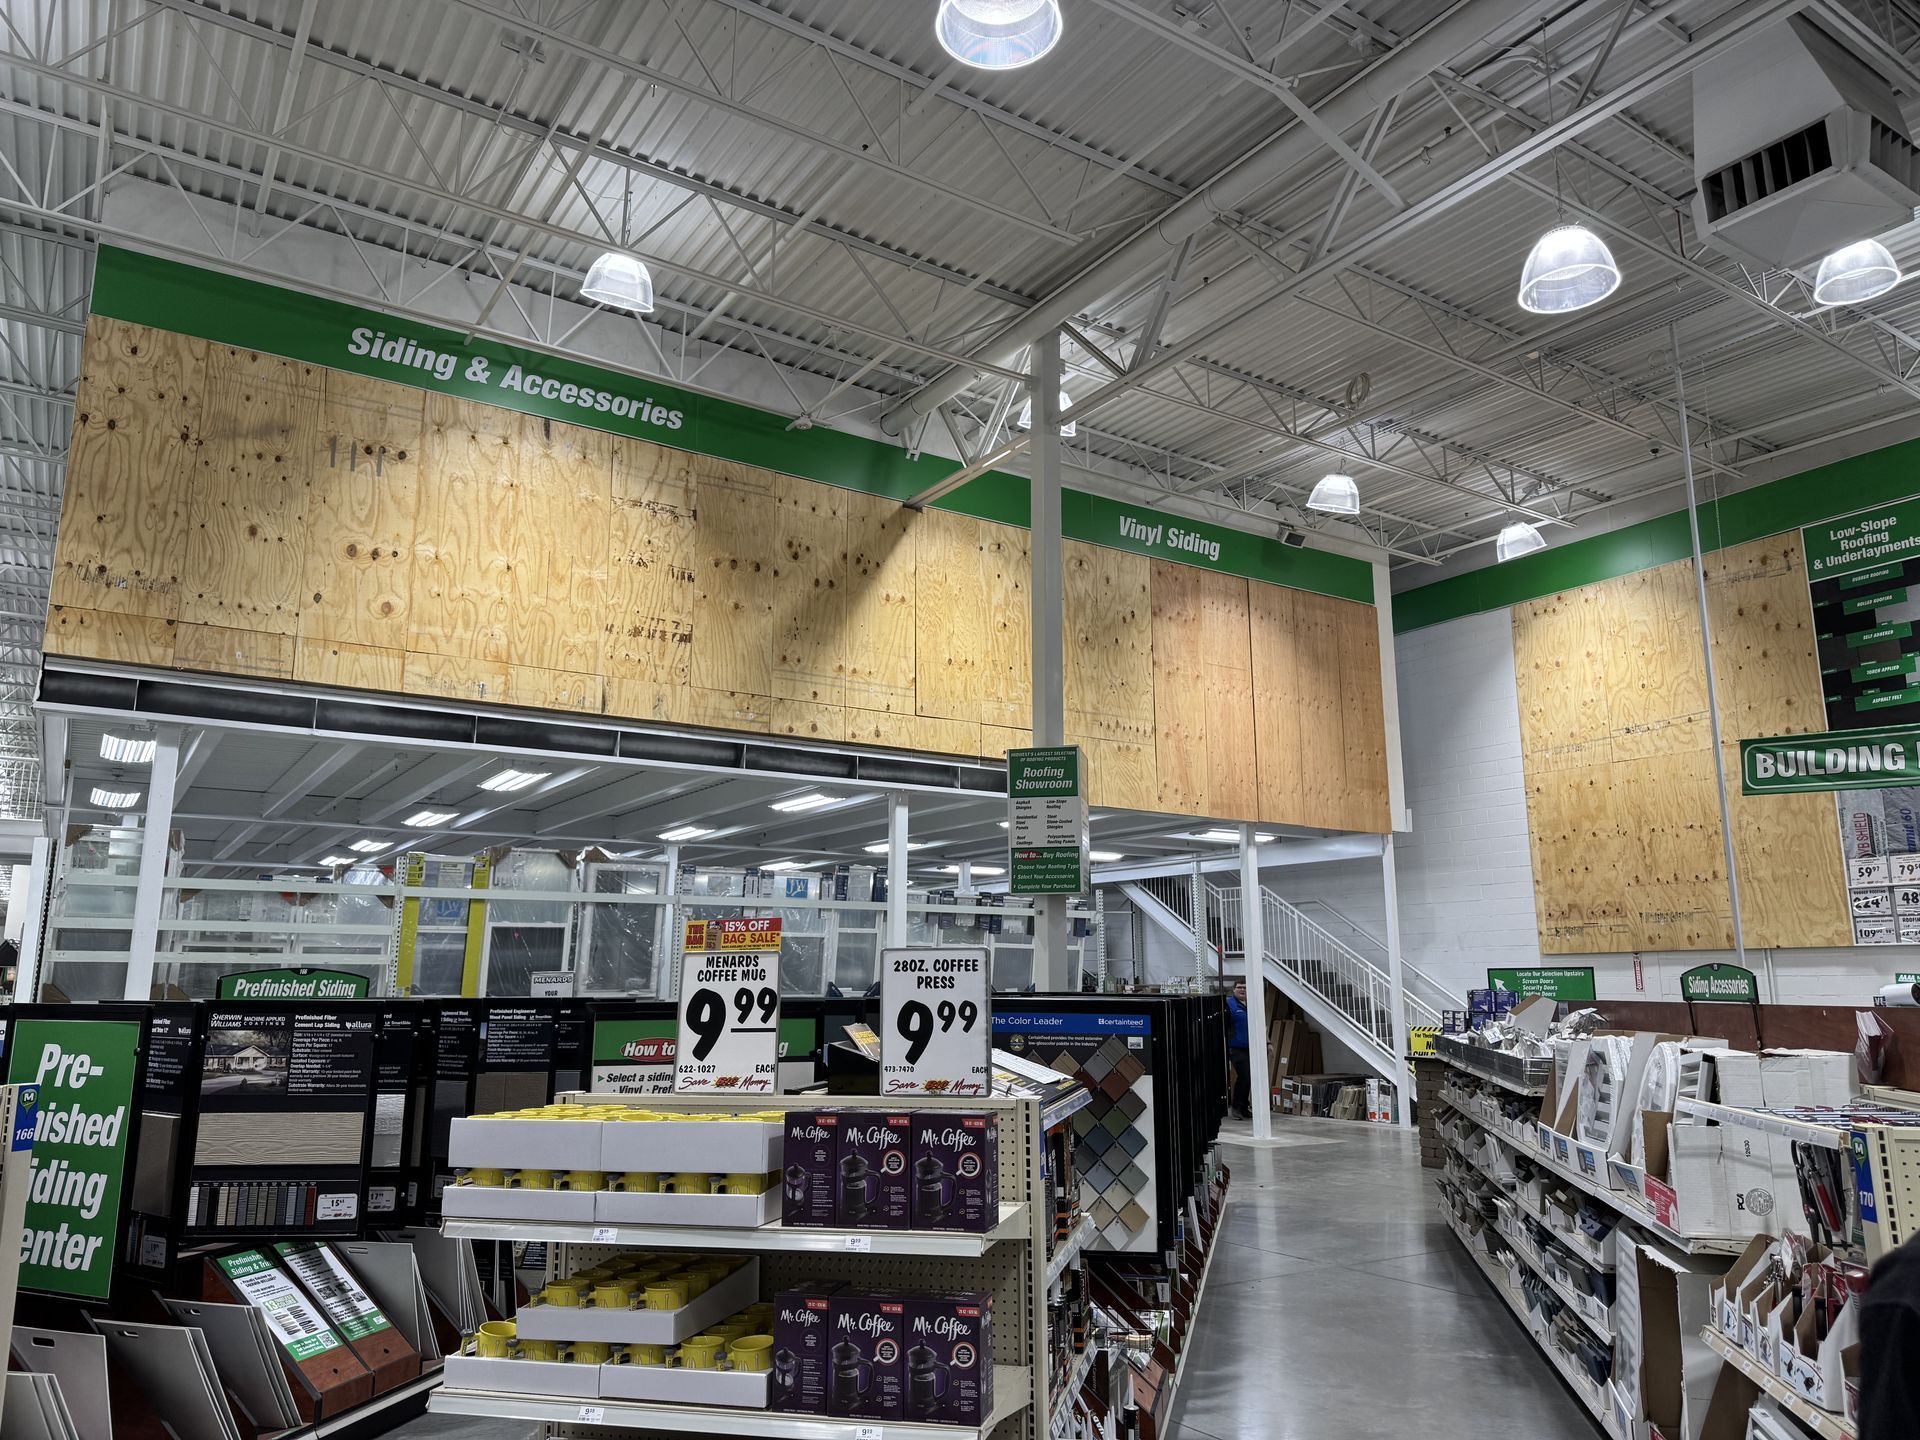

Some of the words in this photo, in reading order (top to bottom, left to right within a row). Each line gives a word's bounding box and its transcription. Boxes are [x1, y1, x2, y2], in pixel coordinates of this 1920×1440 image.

[348, 327, 458, 381] Siding
[465, 356, 491, 386] &
[500, 364, 684, 430] Accessories
[1830, 516, 1896, 540] Low-Slope
[1120, 515, 1162, 546] Vinyl
[1167, 527, 1220, 561] Siding
[1840, 532, 1889, 550] Roofing
[1814, 559, 1822, 570] &
[1870, 569, 1890, 578] ROOFING
[1882, 664, 1900, 672] APPLIED
[1756, 743, 1906, 778] BUILDING
[1023, 766, 1064, 778] Roofing
[1016, 780, 1072, 790] Showroom
[688, 924, 704, 935] THE
[725, 921, 746, 932] 15%
[748, 920, 770, 931] OFF
[723, 933, 746, 944] BAG
[706, 955, 760, 968] MENARDS
[933, 959, 979, 972] COFFEE
[534, 976, 572, 984] MENARDS
[697, 970, 738, 982] COFFEE
[742, 968, 766, 982] MUG
[234, 978, 316, 997] Prefinished
[318, 980, 356, 998] Siding
[916, 976, 955, 990] PRESS
[1688, 976, 1710, 998] Siding
[1710, 975, 1749, 994] Accessories
[210, 1020, 242, 1028] WILLIAMS
[352, 1021, 372, 1029] allura
[992, 1016, 1006, 1024] The
[1008, 1017, 1031, 1025] Color
[1034, 1018, 1063, 1026] Leader
[624, 1042, 658, 1056] How
[35, 1044, 104, 1088] Pre-
[678, 1065, 716, 1074] 622-1027
[756, 1064, 775, 1073] EACH
[972, 1066, 988, 1074] EACH
[606, 1073, 634, 1082] Select
[678, 1076, 711, 1090] Save
[886, 1079, 919, 1093] Save
[33, 1102, 126, 1147] nished
[16, 1128, 34, 1140] 166
[792, 1127, 804, 1139] Mr.
[806, 1126, 830, 1144] Coffee
[846, 1127, 864, 1146] Mr.
[866, 1126, 901, 1150] Coffee
[920, 1129, 940, 1148] Mr.
[942, 1128, 976, 1152] Coffee
[26, 1158, 108, 1220] iding
[1859, 1190, 1874, 1208] 170
[20, 1222, 103, 1272] enter
[231, 1266, 253, 1276] Siding
[781, 1309, 796, 1324] Mr.
[796, 1308, 820, 1328] Coffee
[838, 1313, 857, 1334] Mr.
[858, 1312, 895, 1338] Coffee
[912, 1316, 933, 1337] Mr.
[934, 1316, 972, 1342] Coffee
